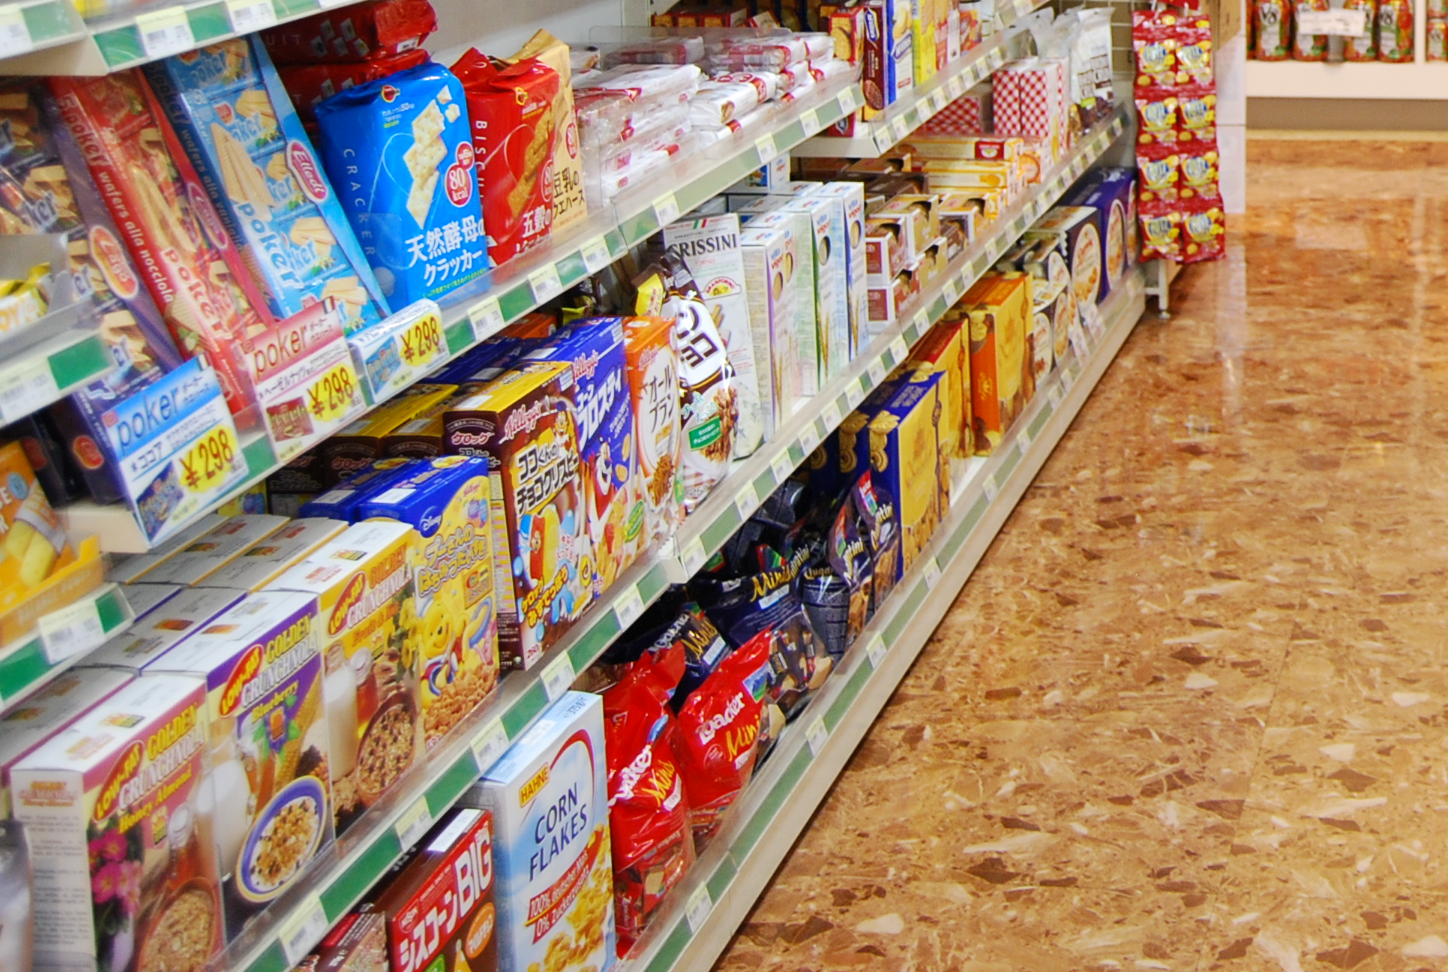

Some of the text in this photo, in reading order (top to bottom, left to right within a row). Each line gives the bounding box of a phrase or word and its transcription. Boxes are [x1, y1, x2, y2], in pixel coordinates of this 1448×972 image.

[343, 147, 376, 257] CRACKER
[448, 168, 466, 190] 80
[452, 188, 469, 205] kcal
[99, 171, 129, 217] wafers
[124, 215, 145, 249] alla
[139, 248, 175, 304] nocciola
[233, 202, 304, 290] poker
[160, 246, 234, 340] poker
[423, 249, 483, 287] クラッカー
[253, 325, 309, 375] poker
[399, 318, 441, 363] ¥298
[116, 384, 180, 453] poker
[306, 365, 355, 420] ¥298
[137, 443, 165, 471] ココア
[178, 428, 235, 489] ¥298
[451, 432, 491, 446] ケロッグ
[425, 525, 474, 567] プーさんの
[329, 577, 366, 636] LOW-FAT
[265, 611, 313, 664] GOLDEN
[220, 648, 263, 714] LOW-FAT
[241, 631, 318, 708] CRUNCHNOLA
[252, 679, 299, 724] Blueberry
[148, 705, 198, 761] GOLDEN
[725, 714, 760, 764] Mini
[95, 743, 143, 820] LOW-FAT
[118, 763, 194, 834] Honey Almond
[519, 765, 549, 806] HAHNE
[534, 782, 578, 845] CORN
[529, 803, 588, 882] FLAKES
[454, 827, 493, 919] BIG
[399, 891, 459, 972] シスコーン
[530, 897, 551, 921] 100%
[535, 920, 550, 940] 0%
